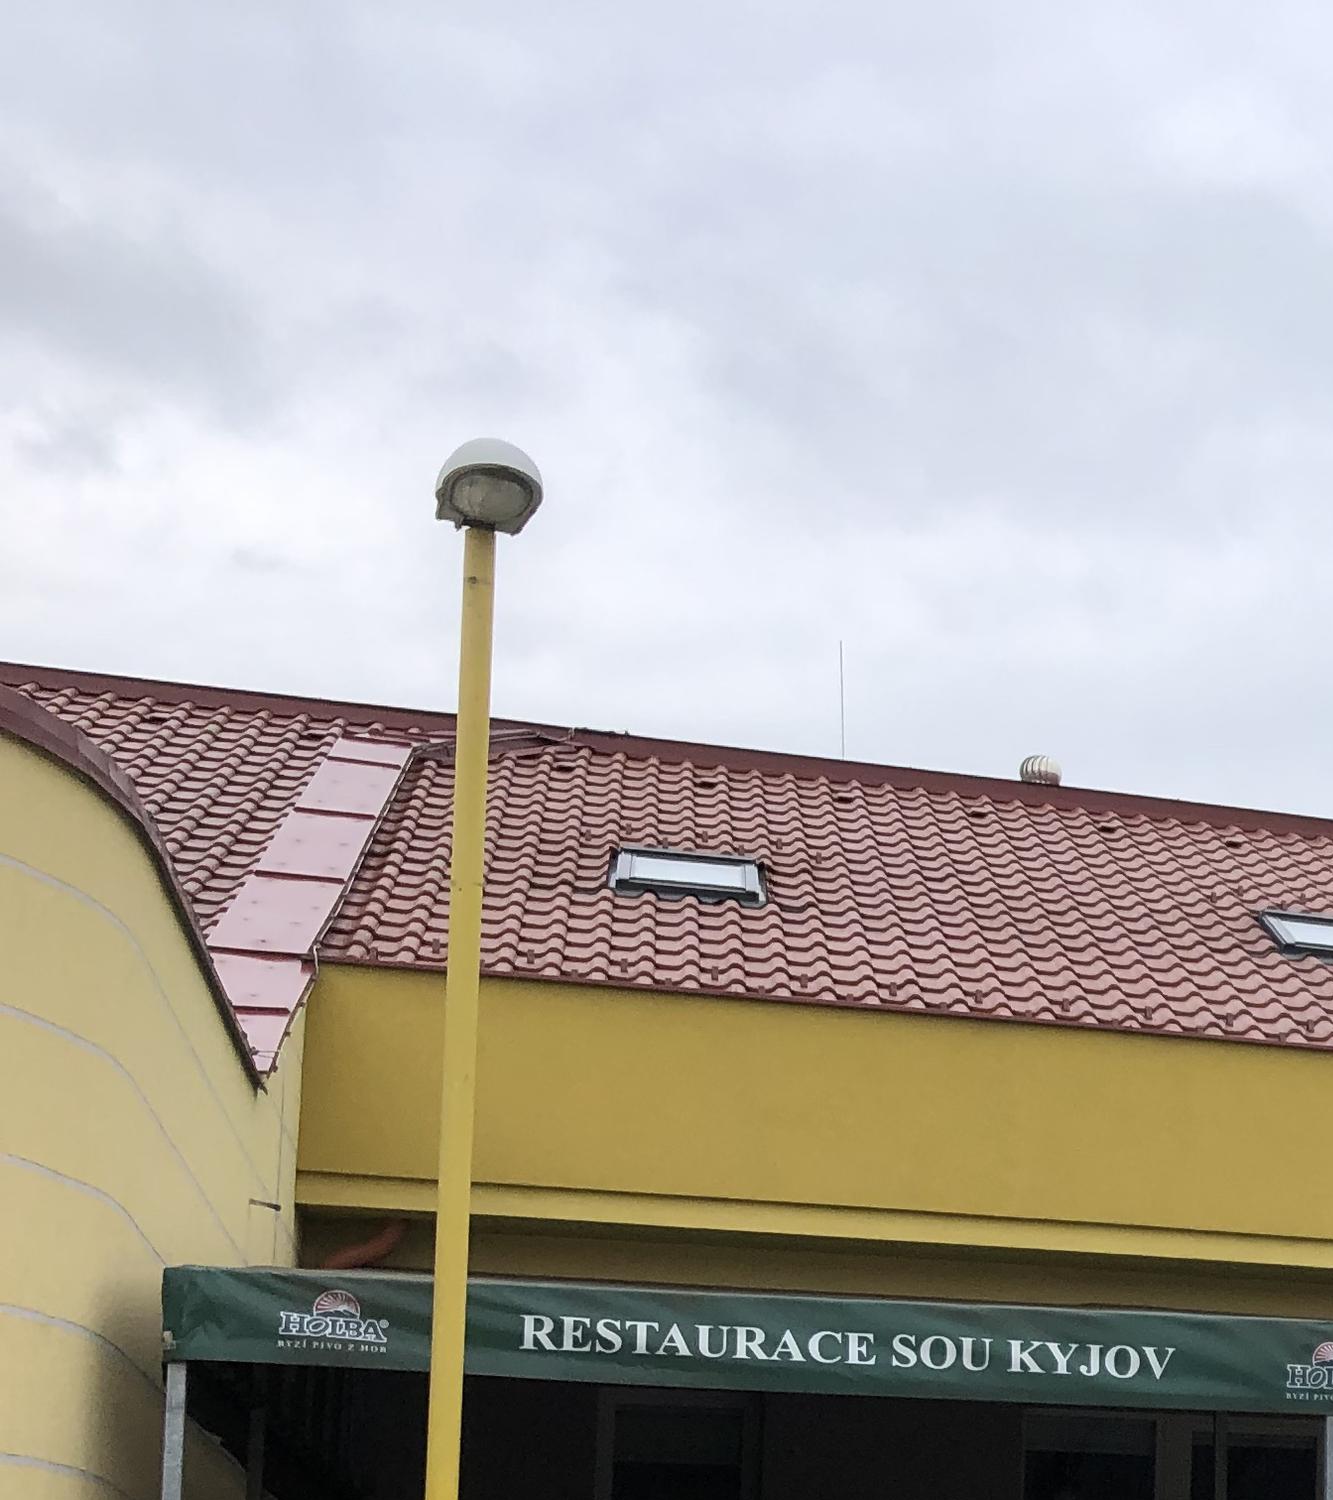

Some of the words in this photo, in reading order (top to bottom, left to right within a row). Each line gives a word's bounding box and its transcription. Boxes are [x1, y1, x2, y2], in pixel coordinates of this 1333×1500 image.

[279, 1311, 387, 1343] HOLBA
[519, 1315, 877, 1365] RESTAURACE
[891, 1334, 994, 1372] SOU
[1006, 1340, 1177, 1381] KYJOV
